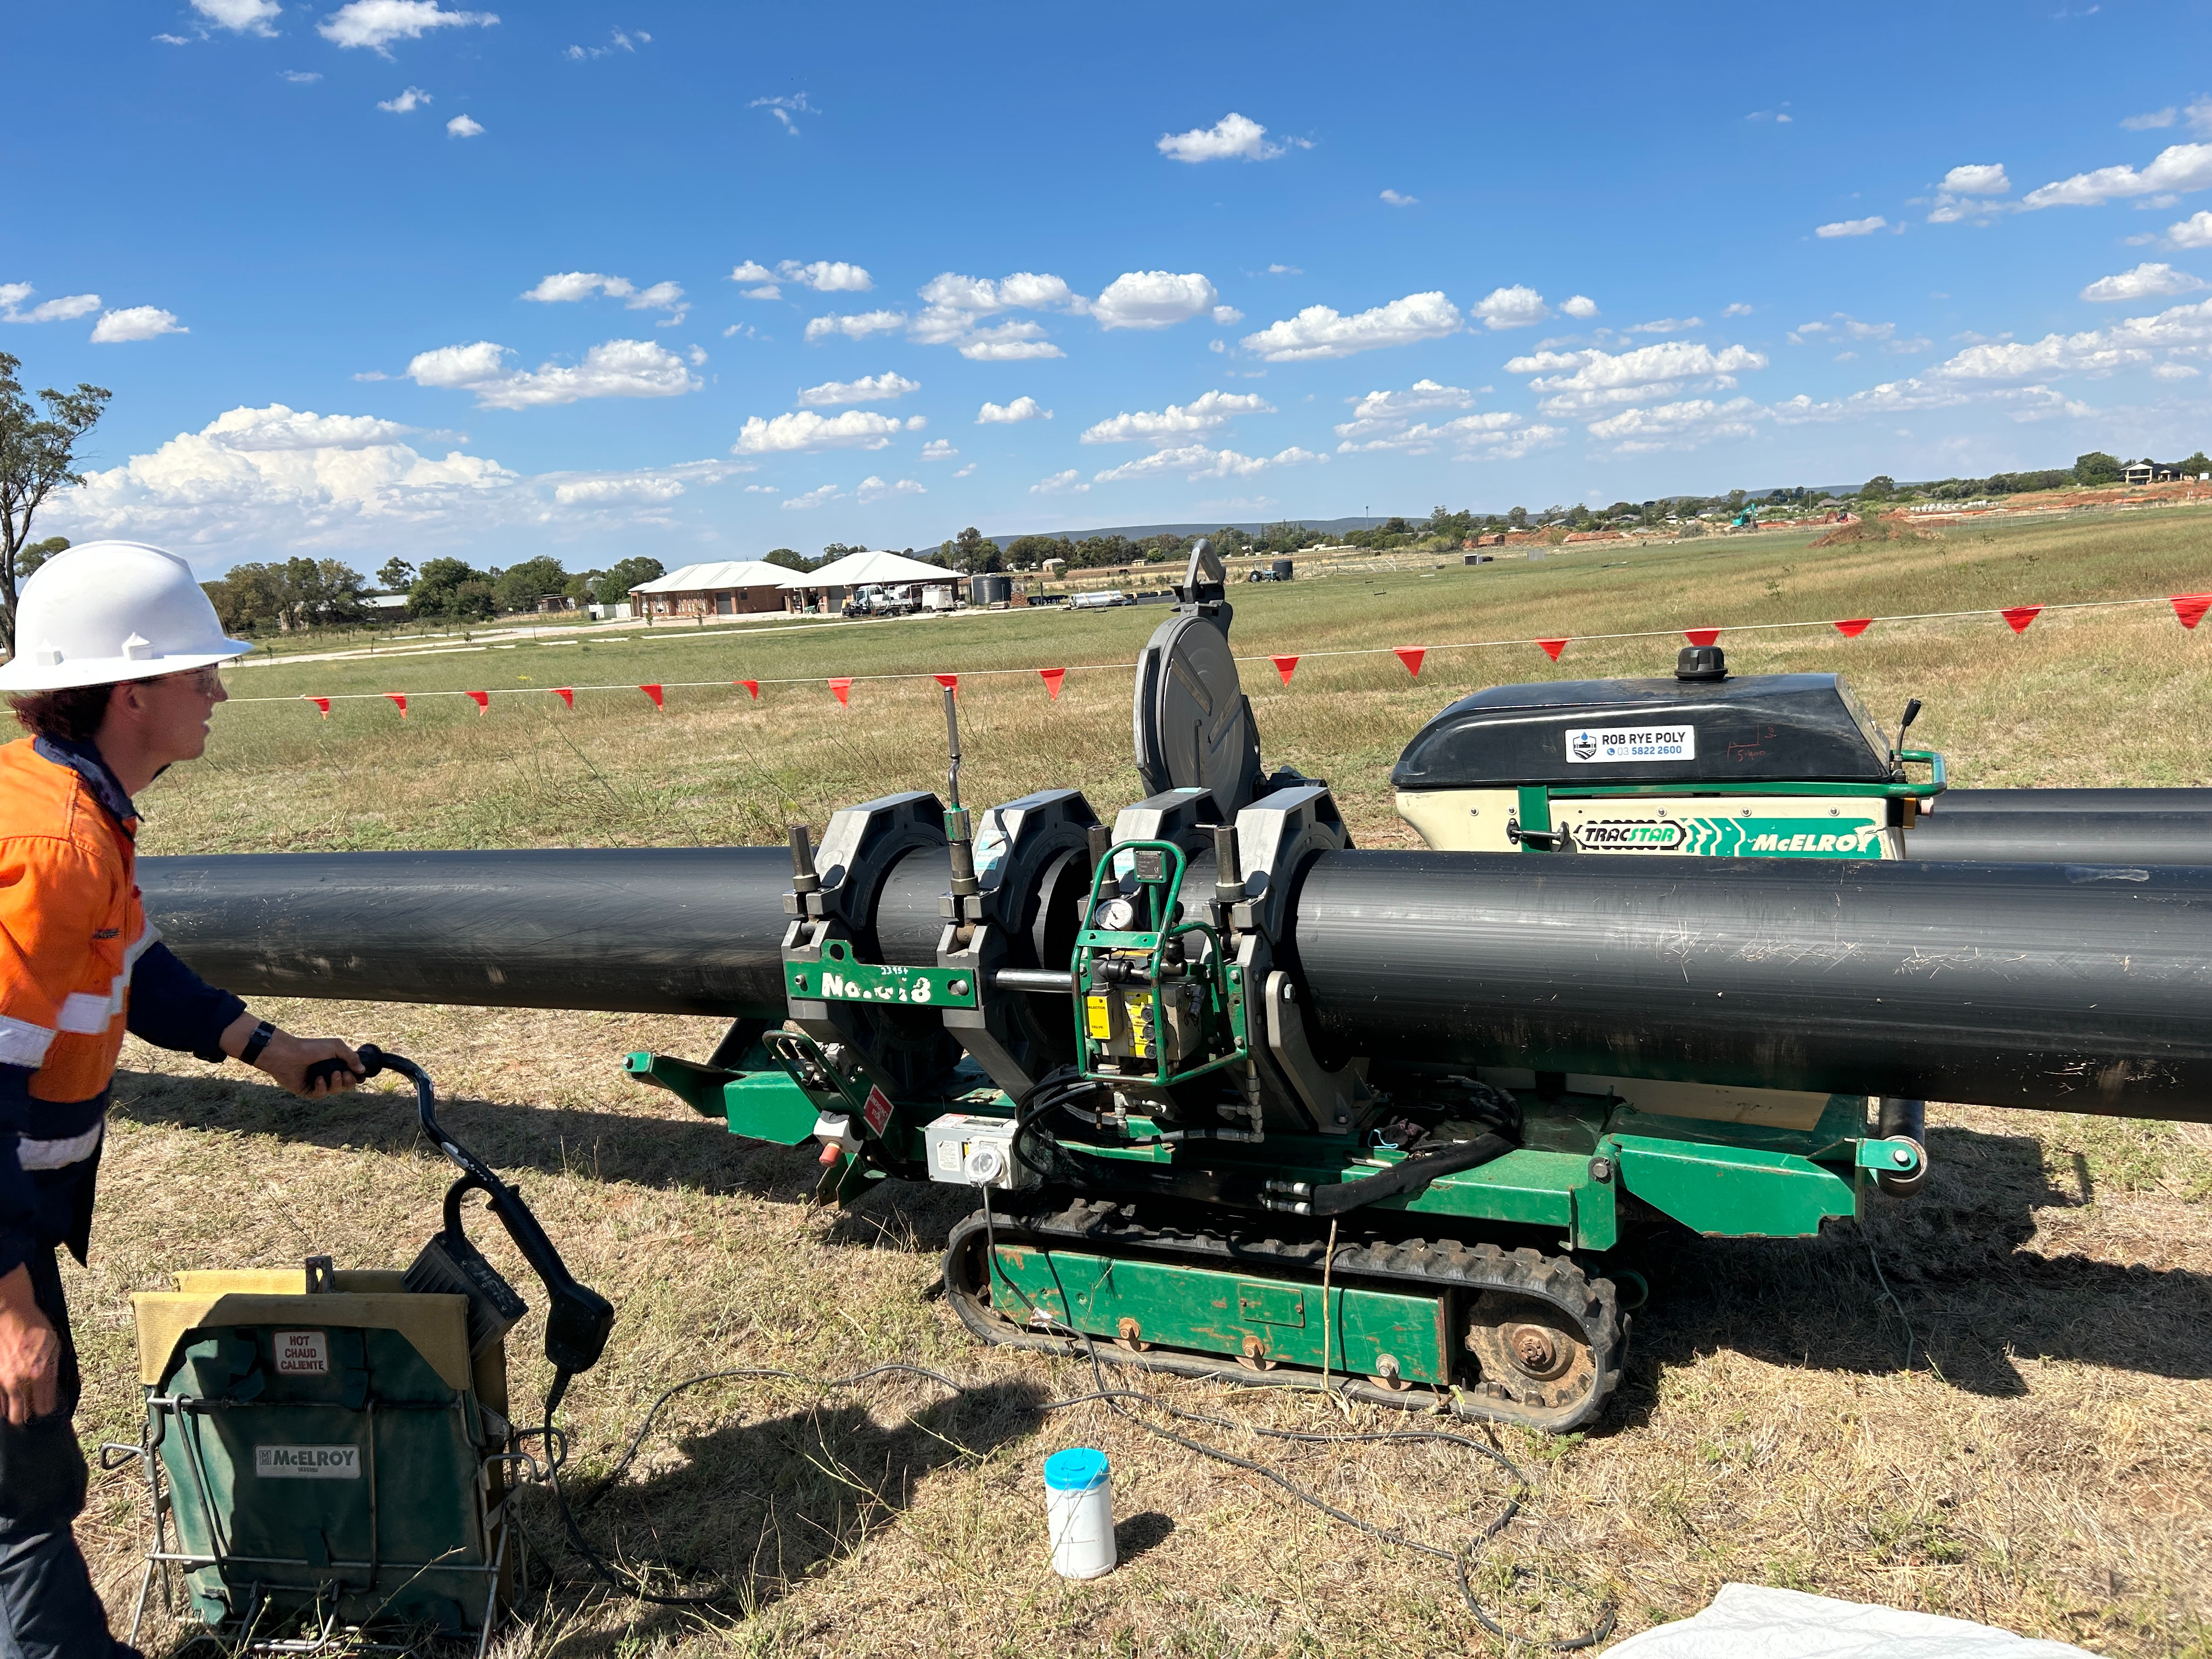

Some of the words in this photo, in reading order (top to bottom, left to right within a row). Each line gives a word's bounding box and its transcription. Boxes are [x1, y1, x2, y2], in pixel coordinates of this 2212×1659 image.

[1602, 734, 1626, 745] ROB
[1629, 733, 1652, 744] RYE
[1655, 732, 1686, 743] POLY
[1617, 747, 1629, 755] 03
[1632, 747, 1655, 755] 5822
[1657, 745, 1682, 754] 2600
[1585, 828, 1675, 842] TRACSTAR
[1751, 833, 1876, 853] McELROY
[289, 1335, 309, 1346] HOT
[284, 1348, 317, 1358] CHAUD
[280, 1360, 324, 1370] CALIENTE
[273, 1450, 354, 1466] McELROY
